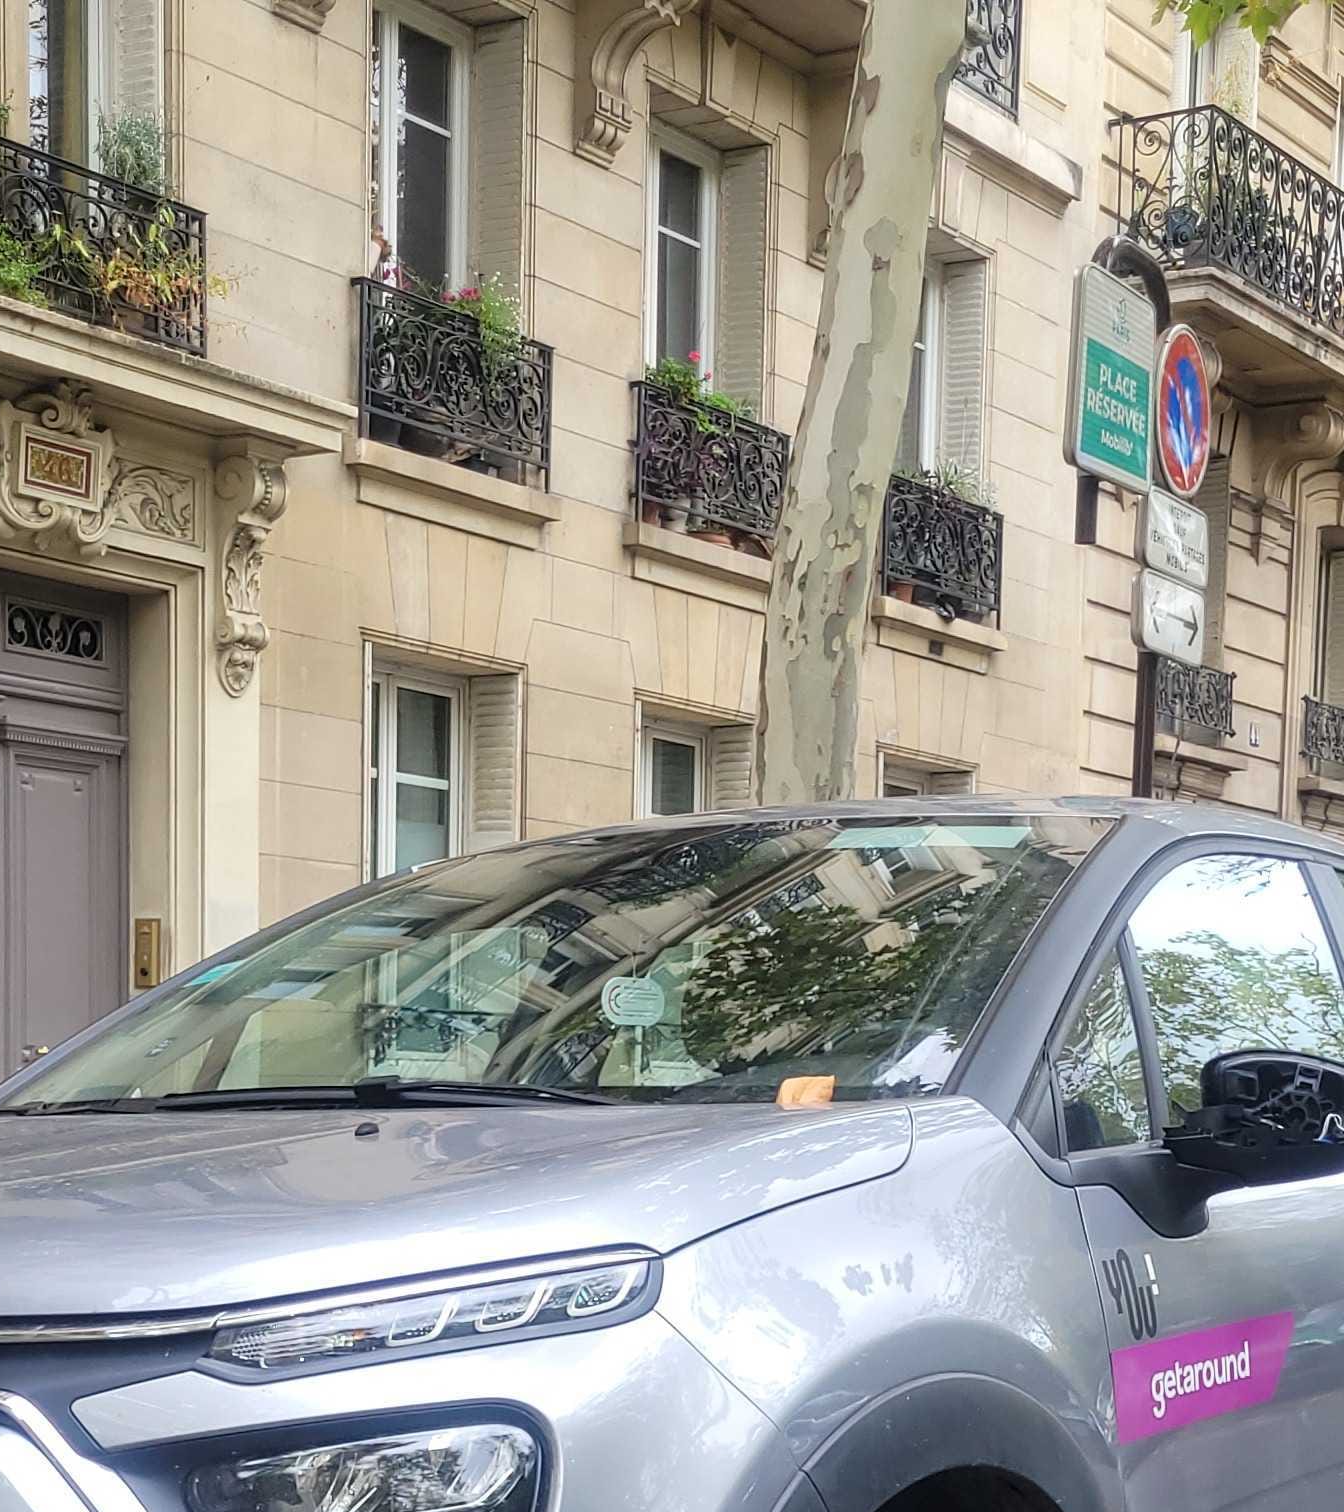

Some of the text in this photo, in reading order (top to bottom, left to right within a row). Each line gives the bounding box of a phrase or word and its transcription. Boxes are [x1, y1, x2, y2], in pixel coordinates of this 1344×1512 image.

[1099, 363, 1137, 403] PLACE
[1087, 386, 1146, 437] RÉSERVÉE
[1150, 1339, 1251, 1420] getaround
